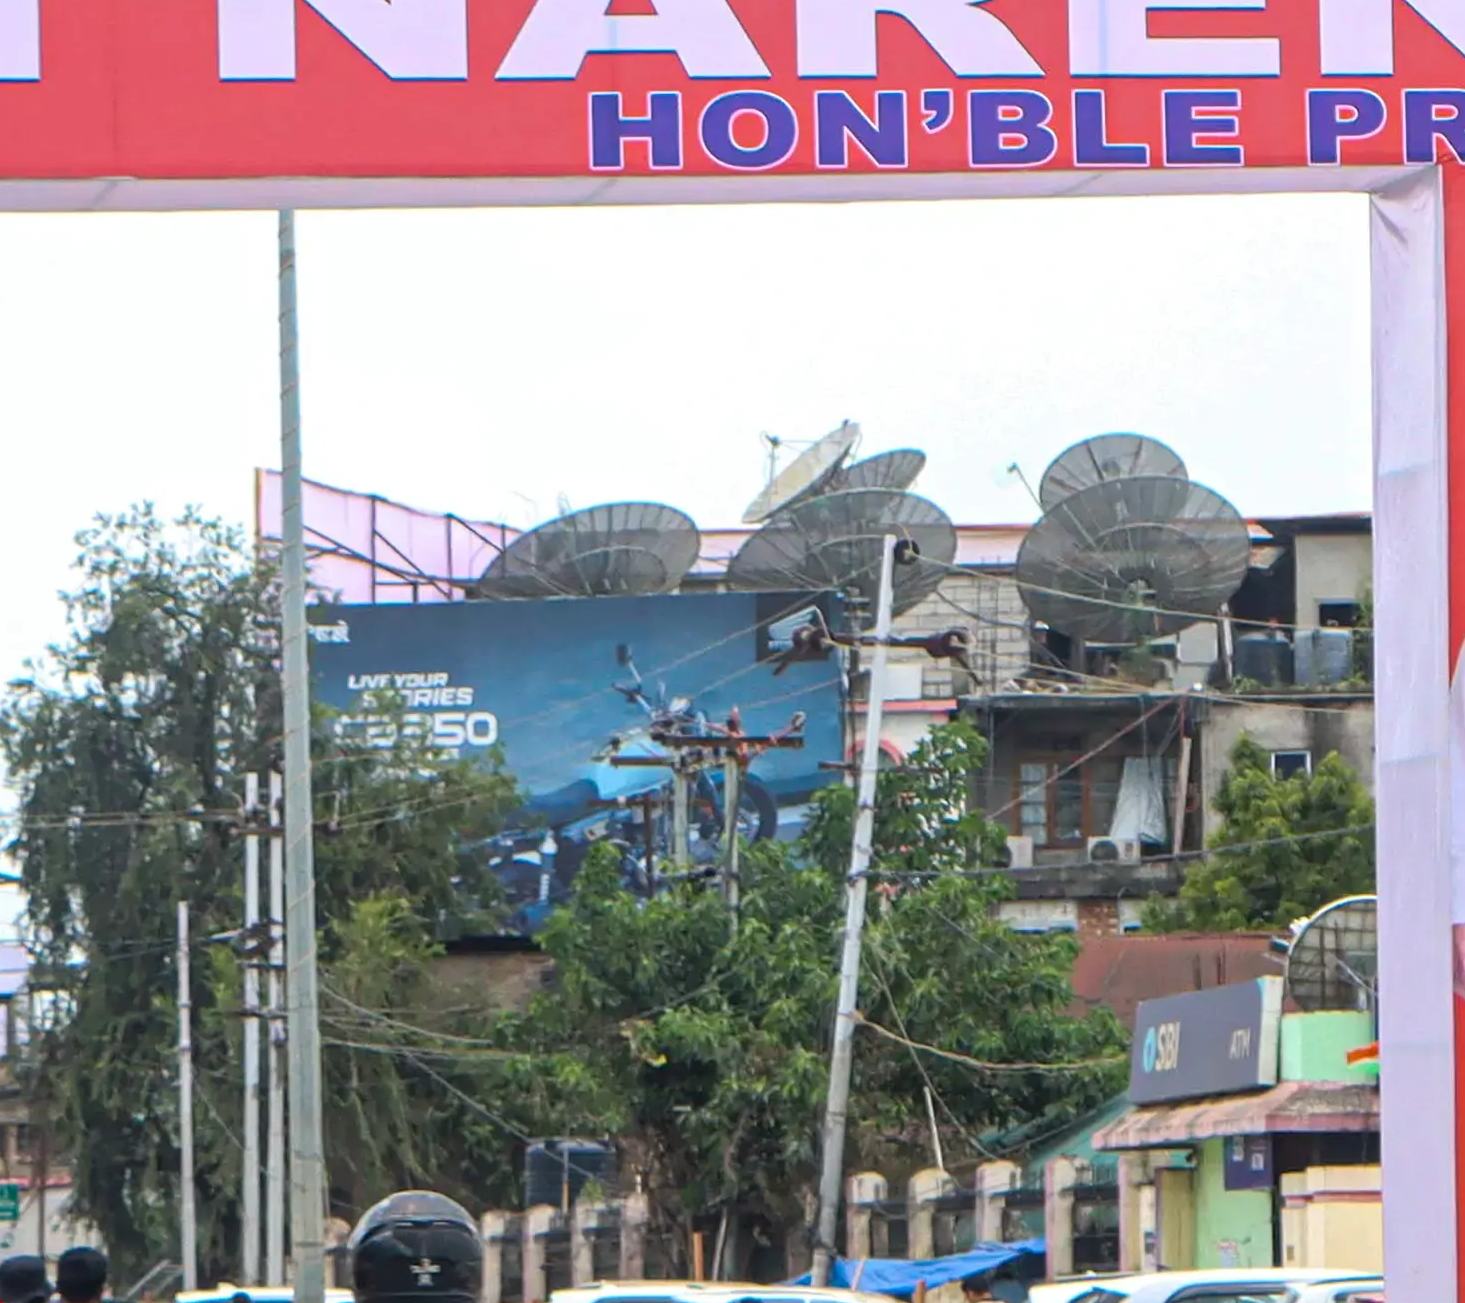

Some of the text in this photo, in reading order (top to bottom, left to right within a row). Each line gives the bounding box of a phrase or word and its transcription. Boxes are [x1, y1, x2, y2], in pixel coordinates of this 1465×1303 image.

[588, 89, 1245, 171] HON'BLE
[363, 687, 474, 708] SRIES
[393, 672, 449, 689] YOUR
[1155, 1021, 1252, 1072] SBI ATM
